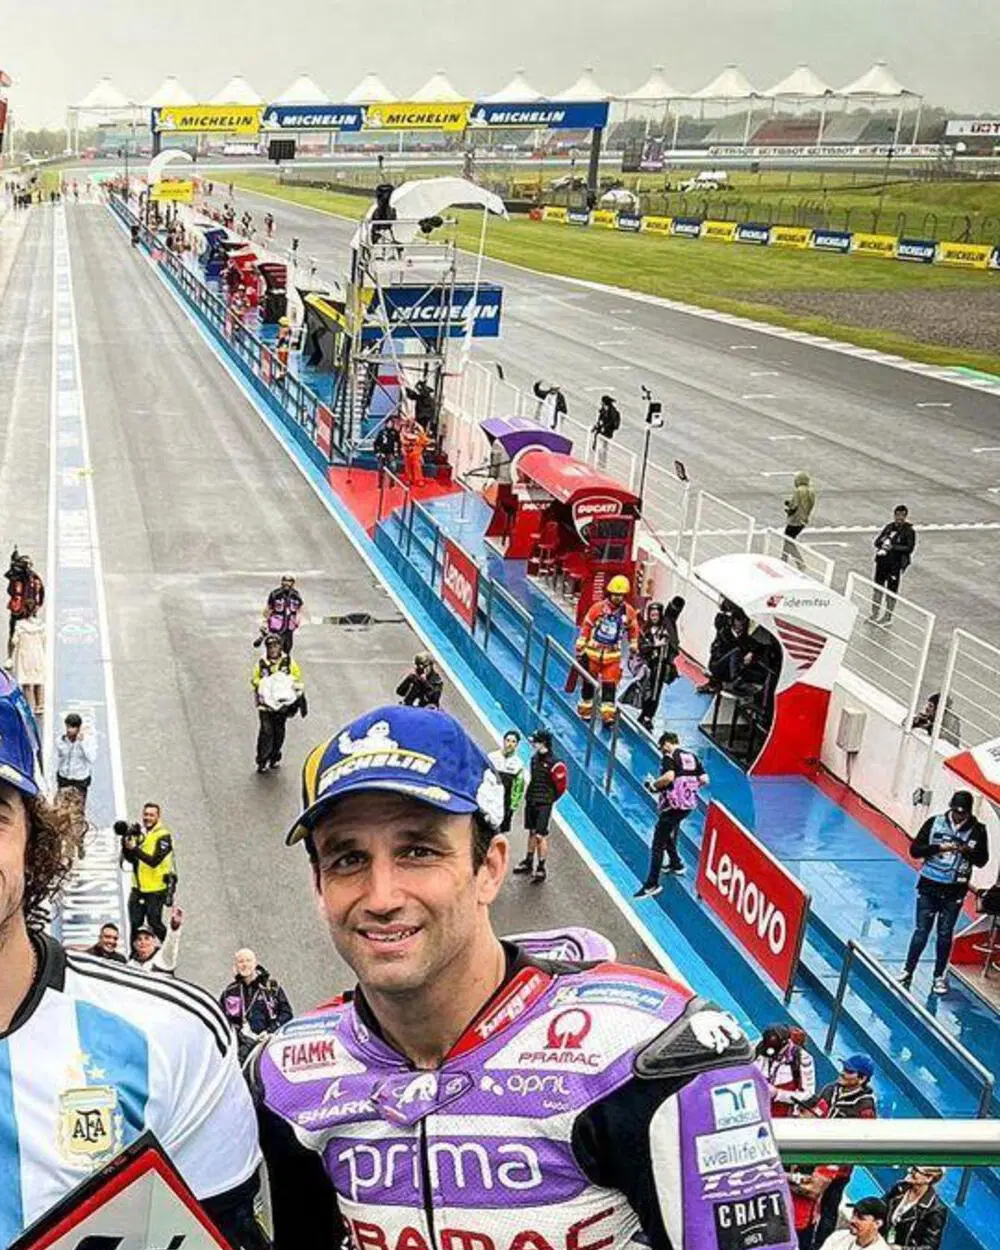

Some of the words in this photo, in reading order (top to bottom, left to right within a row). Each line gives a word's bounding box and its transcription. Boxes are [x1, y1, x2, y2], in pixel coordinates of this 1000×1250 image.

[180, 115, 253, 127] MICHELIN
[282, 114, 358, 126] MICHELIN
[386, 112, 461, 124] MICHELIN
[490, 110, 565, 123] MICHELIN
[577, 502, 617, 514] DUCATI
[444, 551, 474, 609] Lenovo
[318, 753, 434, 795] MICHELIN
[704, 828, 787, 955] Lenovo
[282, 1040, 336, 1067] FIAMM
[518, 1051, 600, 1067] PRAMAC
[297, 1100, 376, 1125] SHARK
[72, 1109, 107, 1143] AFA
[339, 1142, 543, 1202] prima
[718, 1193, 781, 1228] CRAFT
